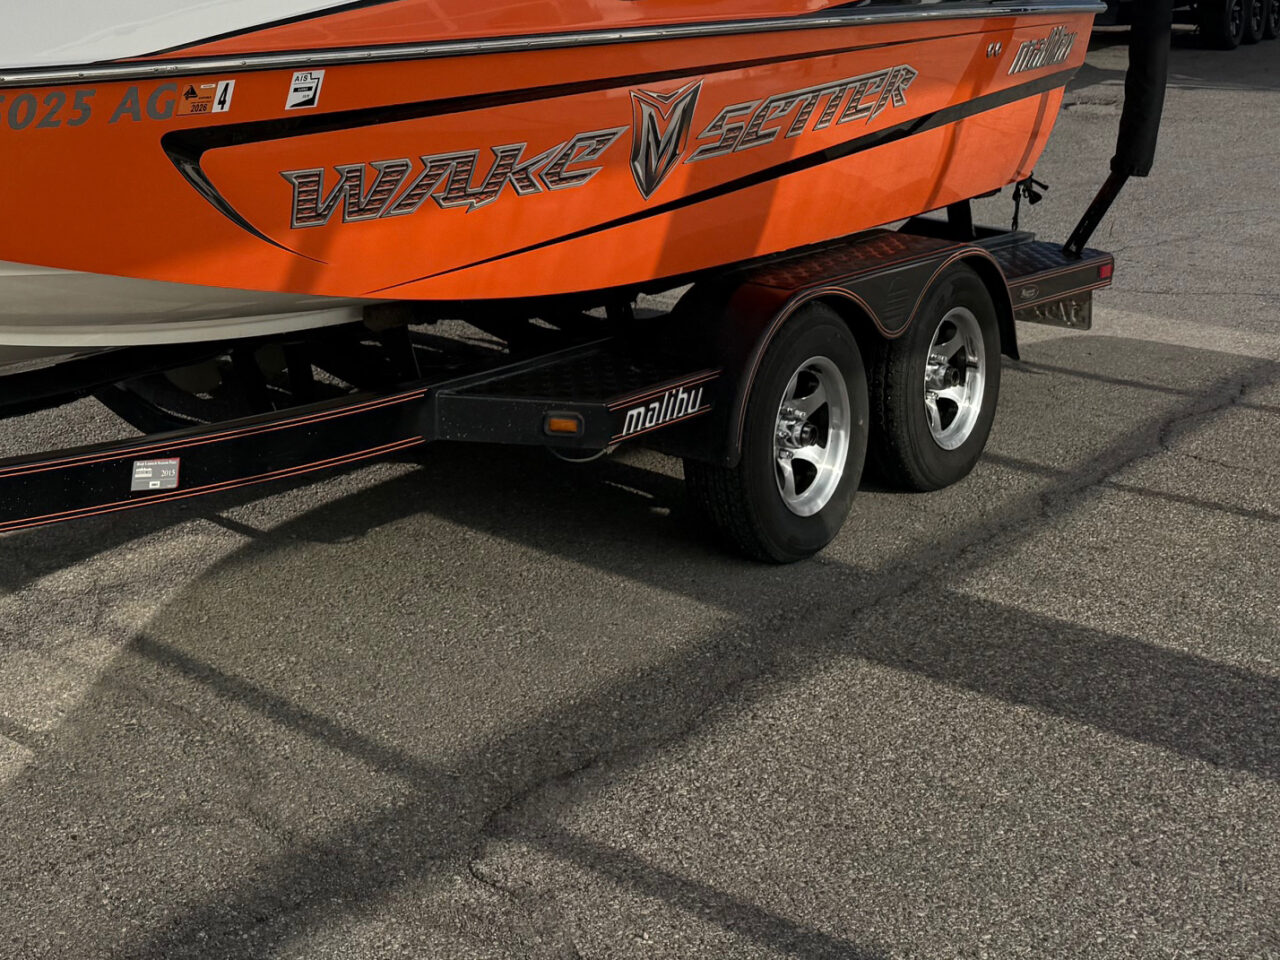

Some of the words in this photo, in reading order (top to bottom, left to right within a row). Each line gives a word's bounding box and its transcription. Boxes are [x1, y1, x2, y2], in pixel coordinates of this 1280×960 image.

[108, 83, 178, 125] AG
[217, 82, 230, 111] 4
[280, 125, 630, 230] WAKE
[682, 63, 919, 165] SETTER
[622, 387, 703, 436] malibu
